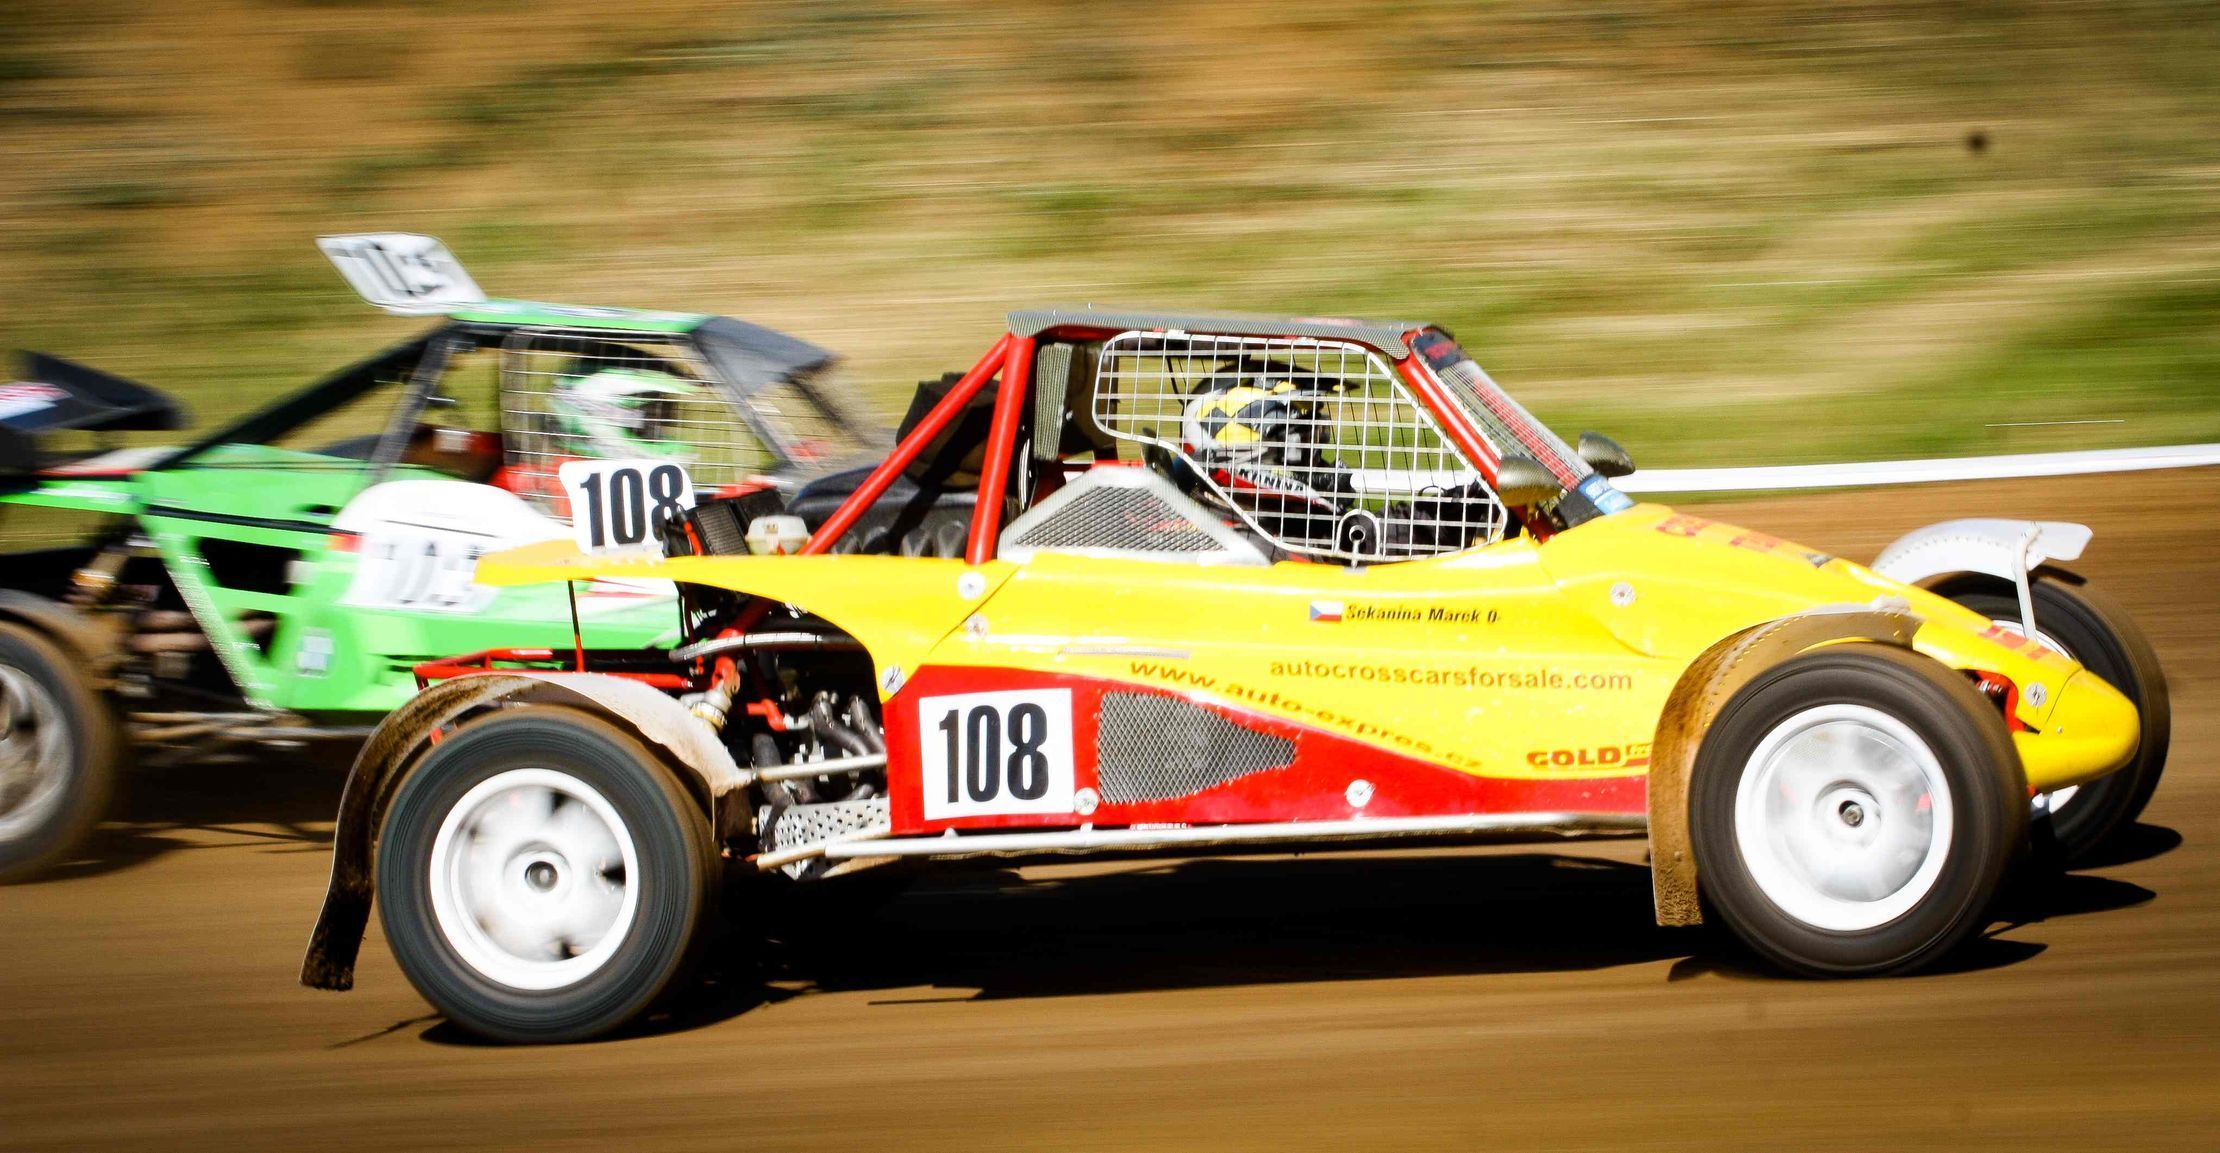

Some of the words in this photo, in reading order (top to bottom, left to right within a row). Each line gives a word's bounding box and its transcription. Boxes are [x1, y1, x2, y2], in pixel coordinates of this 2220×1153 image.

[579, 464, 684, 547] 108
[1346, 604, 1422, 621] Sekanina
[1428, 608, 1480, 623] Marek
[1269, 659, 1634, 690] autocrosscarsforsale.com
[1129, 660, 1484, 770] www.auto-expres.cz
[938, 702, 1049, 804] 108
[1526, 746, 1622, 767] GOLD
